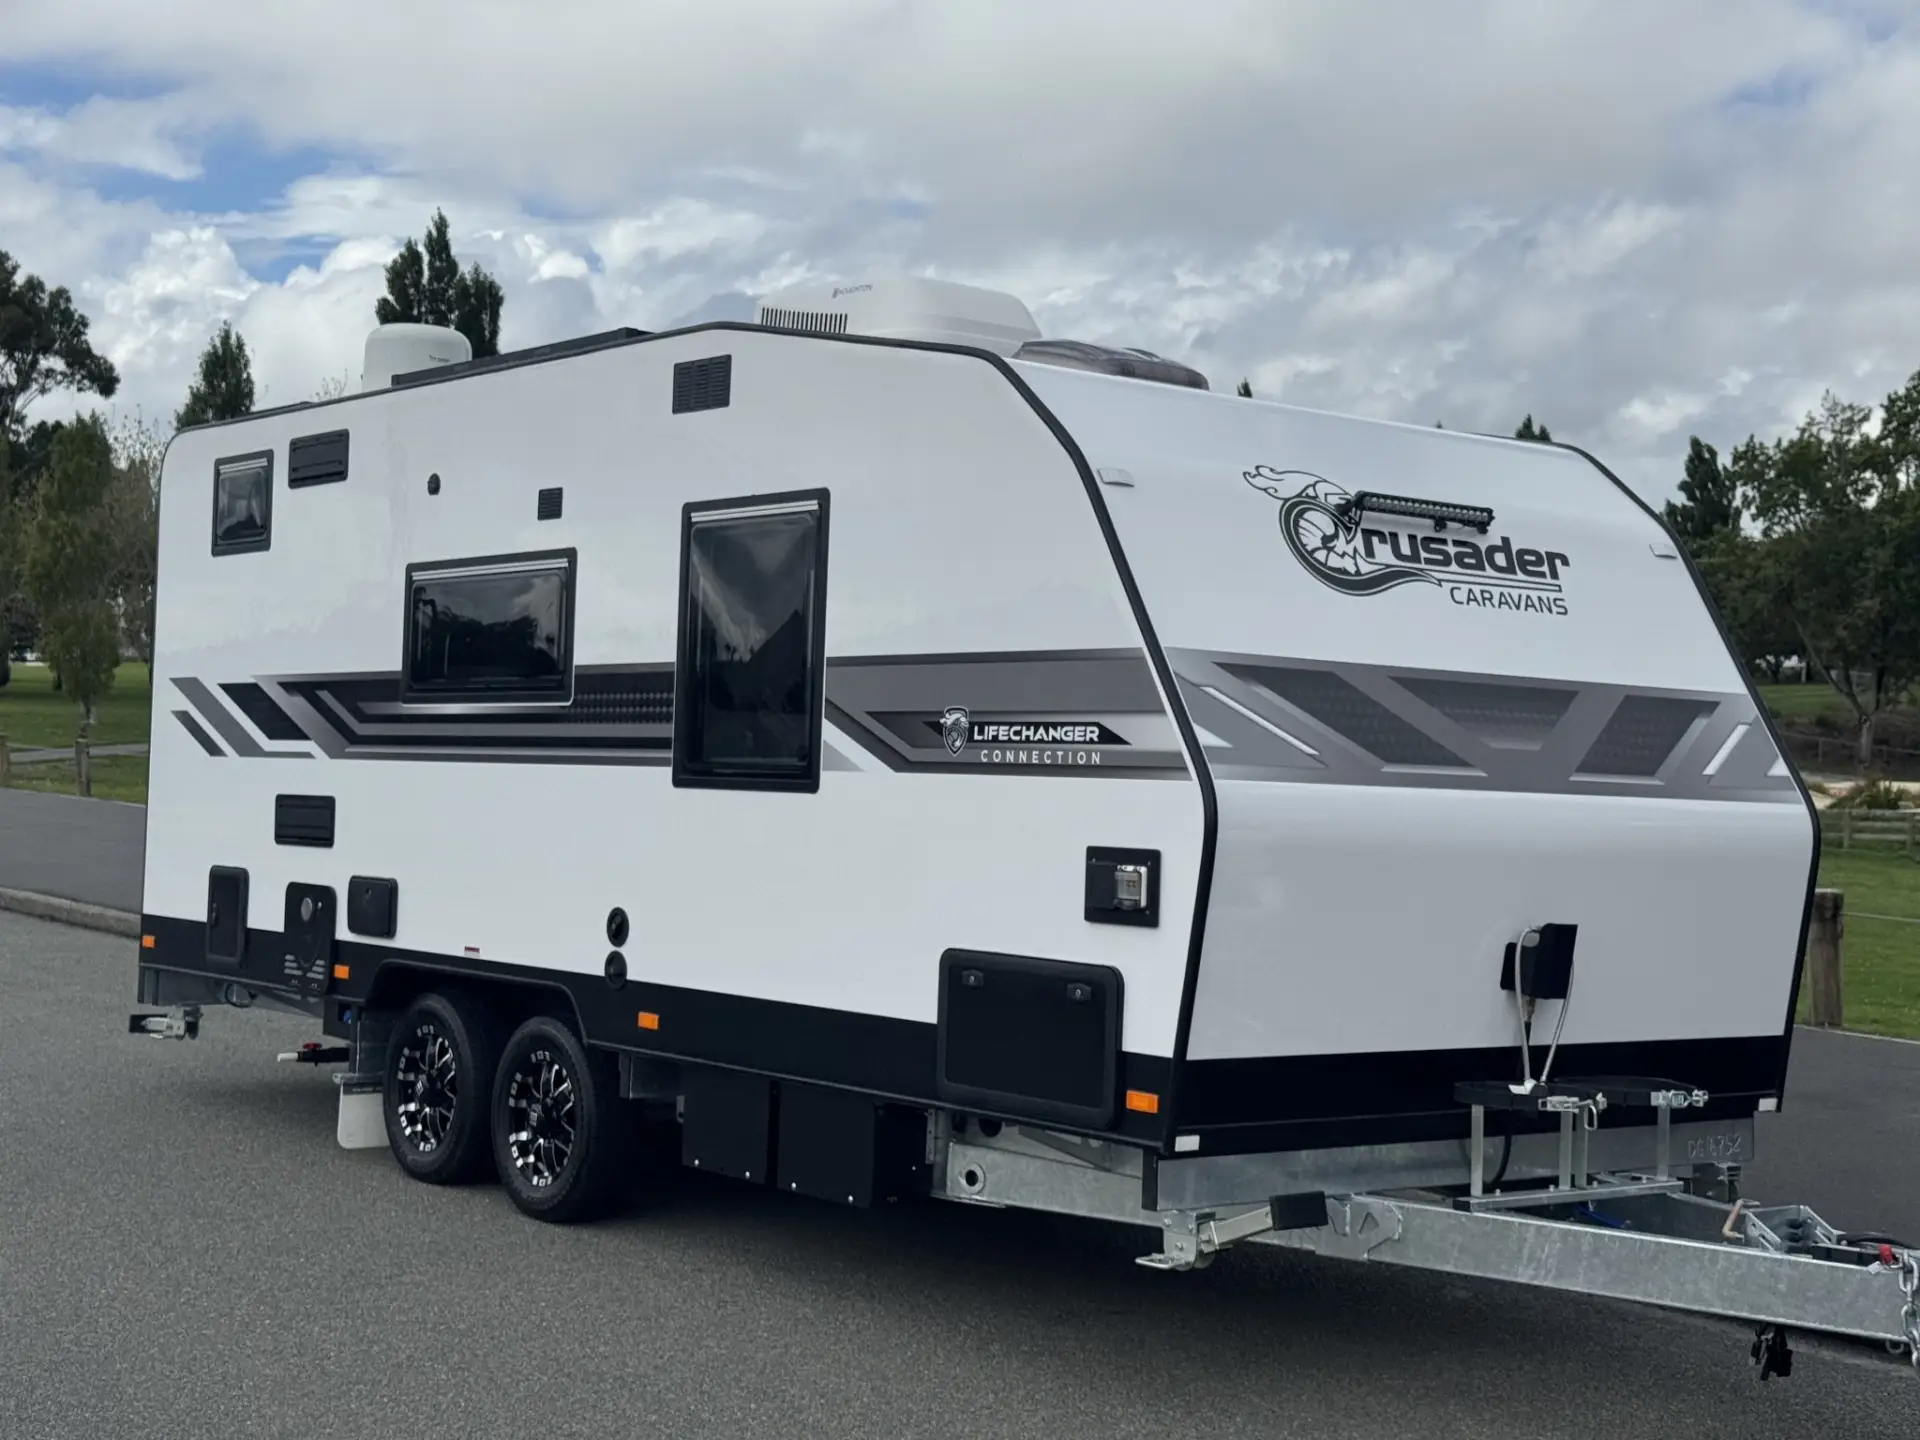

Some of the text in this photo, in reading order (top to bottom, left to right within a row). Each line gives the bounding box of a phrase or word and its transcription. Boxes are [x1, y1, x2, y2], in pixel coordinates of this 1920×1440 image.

[1450, 586, 1569, 616] CARAVANS
[973, 725, 1100, 742] LIFECHANGER
[981, 750, 1101, 765] CONNECTION
